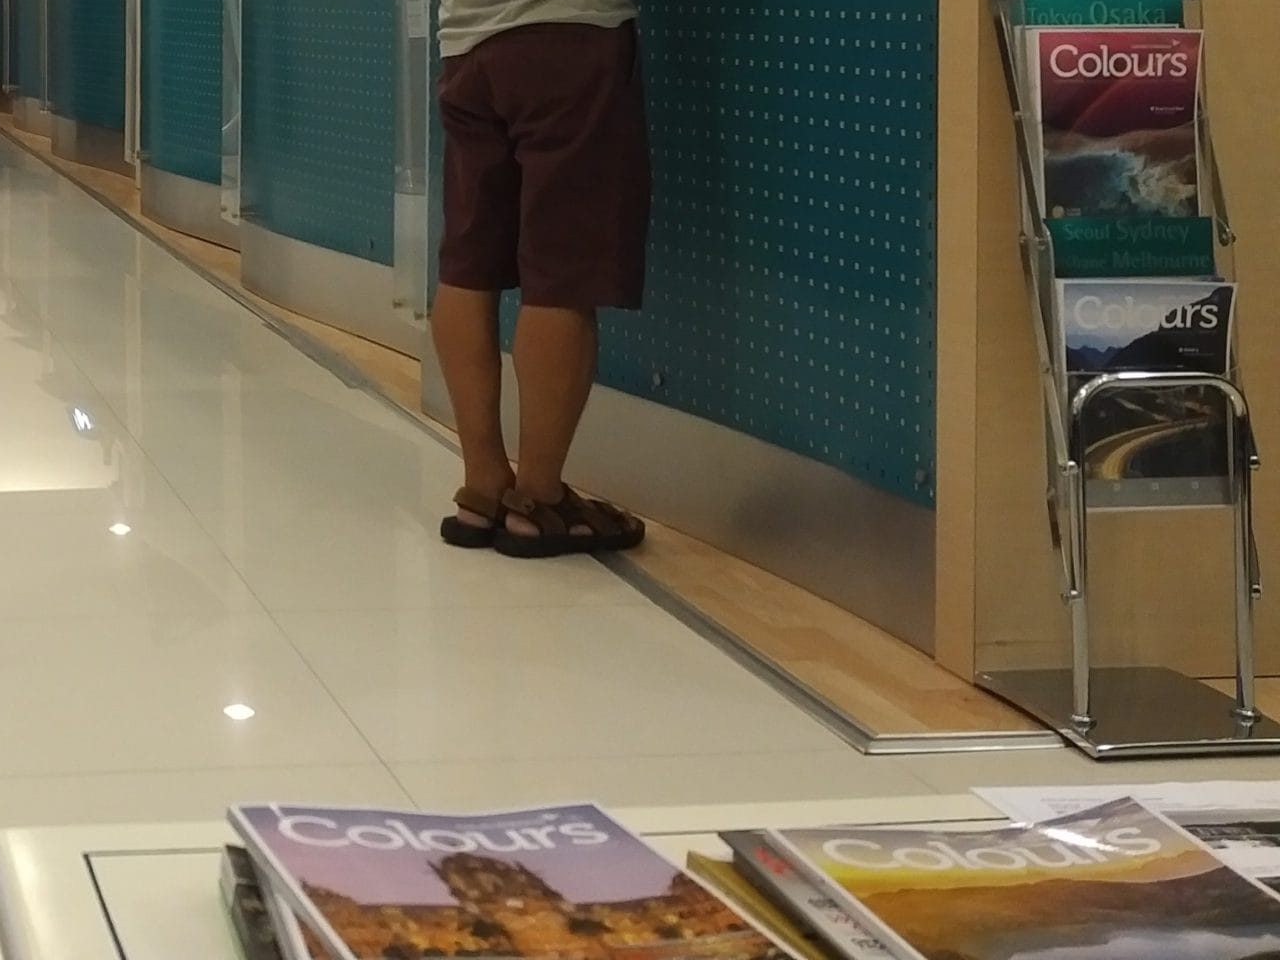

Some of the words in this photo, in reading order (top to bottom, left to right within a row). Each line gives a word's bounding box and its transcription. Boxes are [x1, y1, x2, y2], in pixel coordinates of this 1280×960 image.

[1026, 7, 1083, 25] Tokyo
[1089, 0, 1166, 25] Osaka
[1050, 43, 1188, 78] Colours
[1063, 223, 1110, 241] Seoul
[1115, 218, 1190, 245] Sydney
[1074, 295, 1218, 329] Colours
[278, 815, 610, 853] Colours
[822, 826, 1161, 871] Colours
